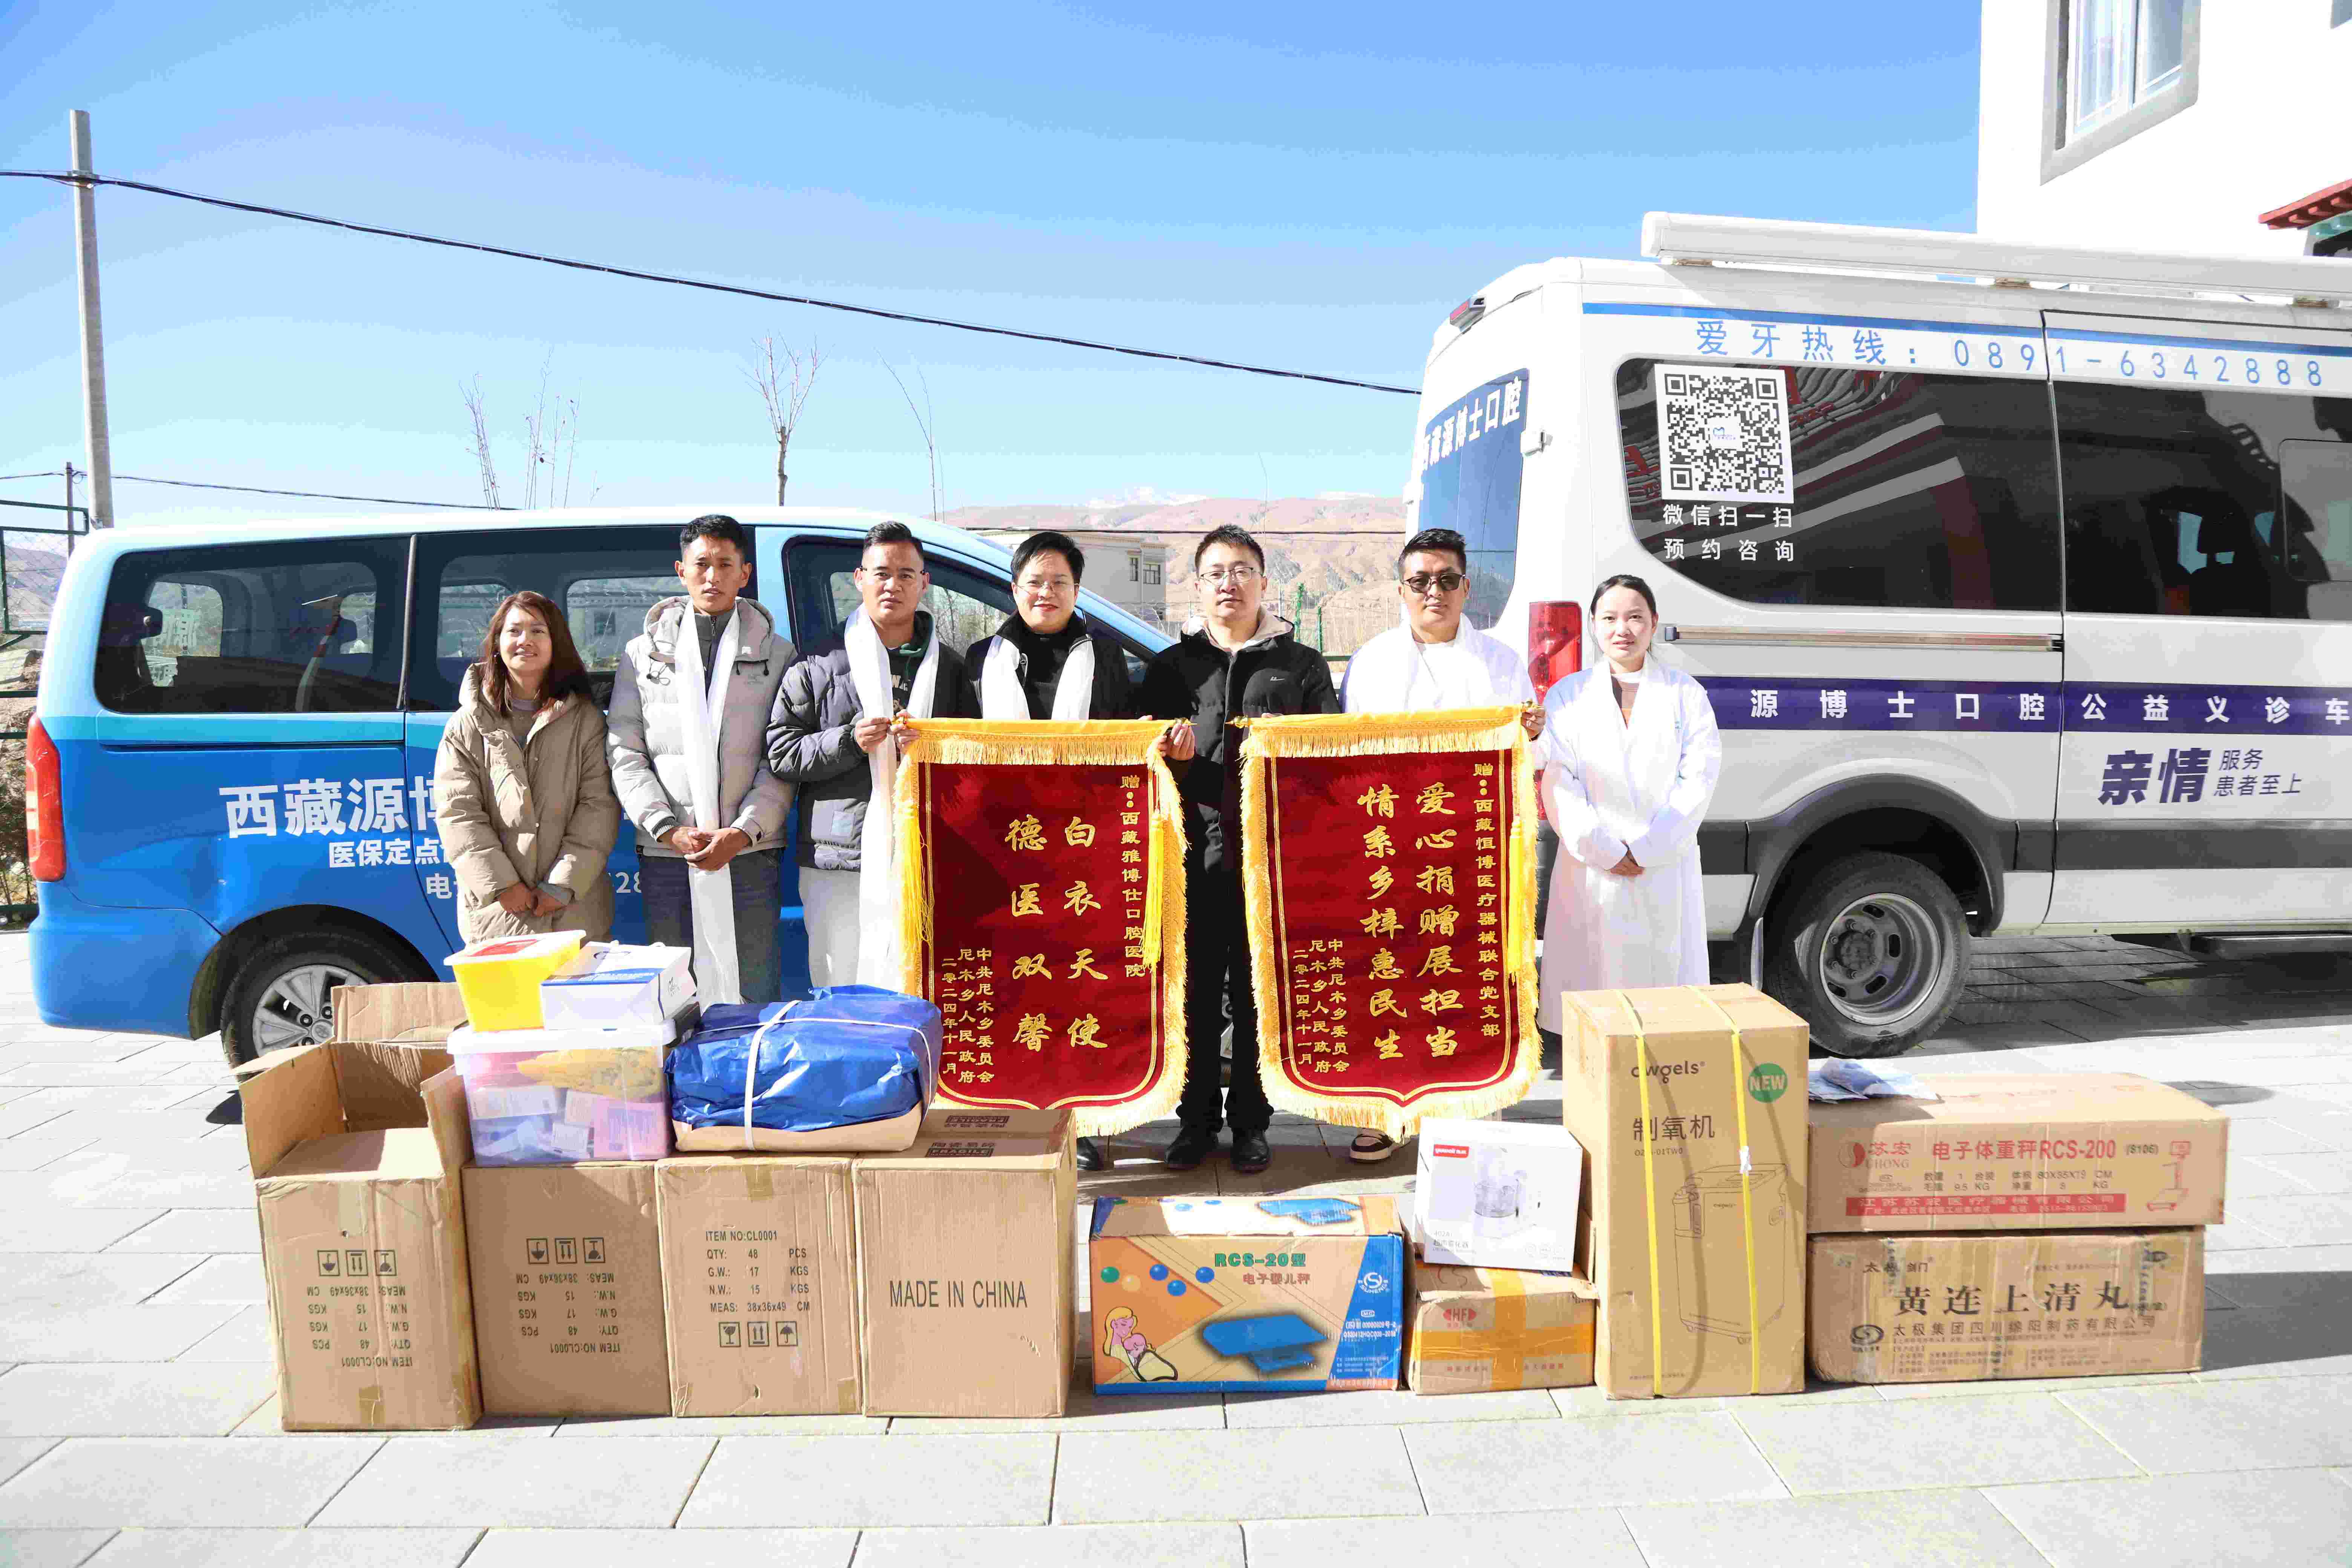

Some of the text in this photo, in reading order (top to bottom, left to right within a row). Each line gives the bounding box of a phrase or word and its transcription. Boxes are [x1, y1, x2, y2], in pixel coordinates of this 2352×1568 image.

[1663, 504, 1792, 528] 微信扫一扫
[1664, 538, 1793, 562] 预约咨询
[2219, 748, 2263, 770] 服务
[2097, 747, 2211, 805] 亲情
[2212, 773, 2302, 796] 患者至上
[329, 838, 450, 868] 医保定点
[1357, 783, 1407, 1060] 情系乡梓惠民生
[1415, 782, 1465, 1058] 爱心捐赠展担当
[1004, 814, 1053, 1052] 德医双馨
[1064, 816, 1109, 1049] 白衣天使
[1292, 949, 1313, 1065] 二零二四年十一月
[1309, 939, 1332, 1073] 尼木乡人民政府
[1328, 939, 1350, 1072] 中共尼木乡委员会
[941, 958, 959, 1075] 二零二四年十一月
[958, 948, 976, 1084] 尼木乡人民政府
[976, 948, 995, 1083] 中共尼木乡委员会
[1749, 1074, 1786, 1092] NEW
[1633, 1114, 1715, 1142] 制氧机
[1933, 1139, 2116, 1160] 电子体重秤RCS-200
[1975, 1182, 1990, 1191] KG
[2092, 1180, 2109, 1188] KG
[706, 1230, 778, 1241] ITEM NO:CL0001
[707, 1248, 807, 1259] QTY: 48 PCS
[1214, 1253, 1306, 1268] RCS-20型
[586, 1272, 614, 1283] MEAS:
[750, 1267, 759, 1276] 17
[790, 1266, 809, 1276] KGS
[516, 1274, 530, 1283] CM
[307, 1287, 320, 1297] CM
[378, 1286, 406, 1296] MEAS:
[751, 1285, 760, 1294] 15
[790, 1284, 809, 1294] KGS
[889, 1280, 1028, 1308] MADE IN CHINA
[517, 1291, 536, 1301] KGS
[565, 1291, 575, 1301] 15
[1892, 1280, 2130, 1317] 黄连上清丸
[308, 1305, 327, 1314] KGS
[356, 1305, 366, 1314] 15
[710, 1301, 810, 1312] MEAS: 38x36x49 CM
[518, 1309, 537, 1318] KGS
[567, 1309, 576, 1318] 17
[309, 1322, 328, 1332] KGS
[358, 1322, 368, 1332] 17
[521, 1326, 619, 1336] QTY: 48 PCS
[312, 1340, 411, 1349] QTY: 48 PCS
[600, 1343, 620, 1353] ITEM
[392, 1357, 412, 1367] ITEM
